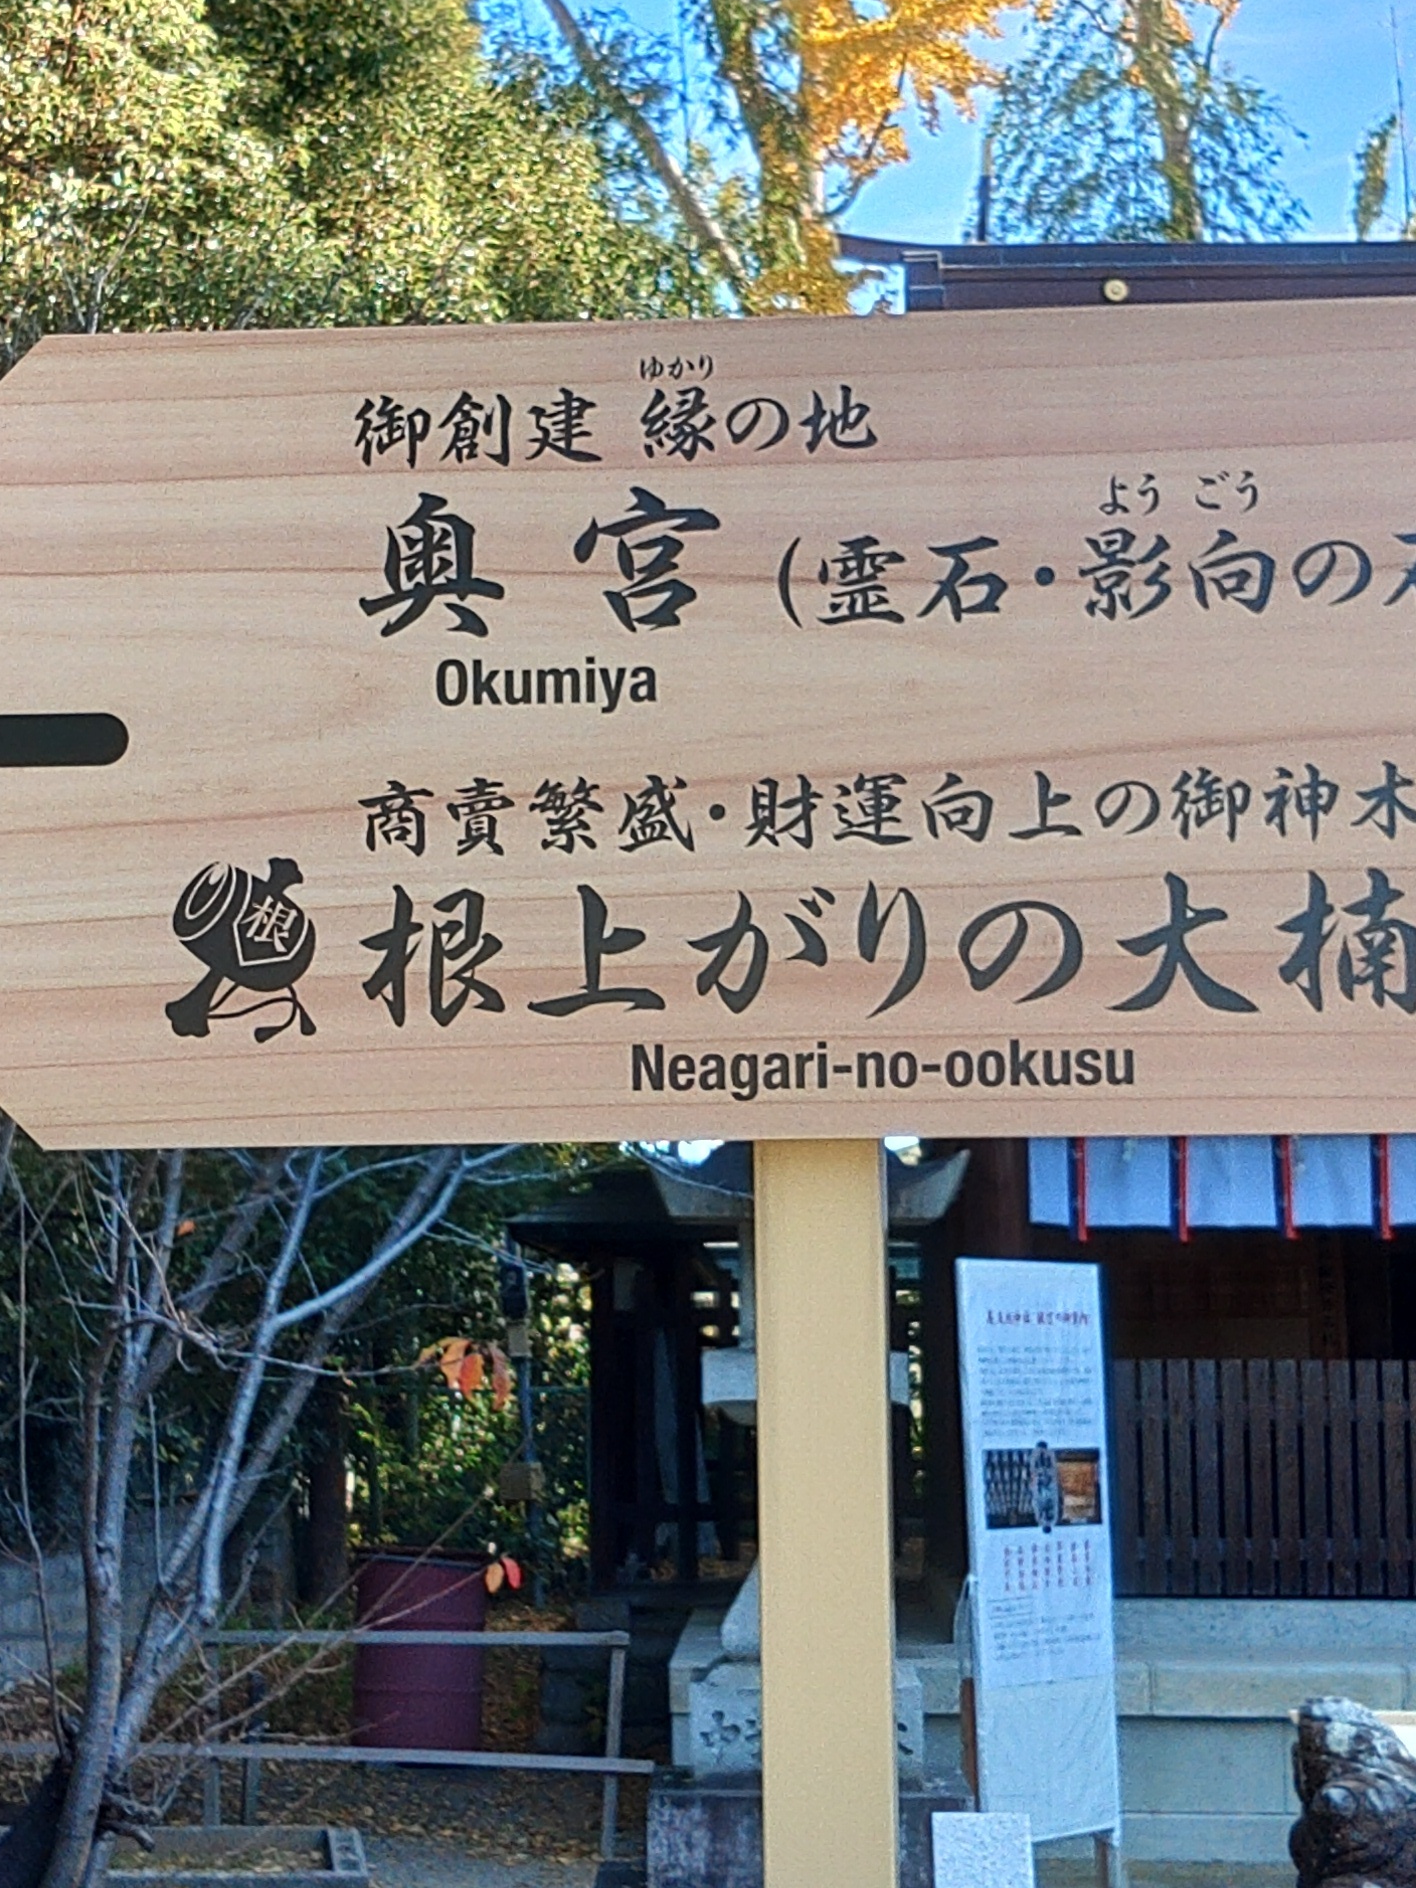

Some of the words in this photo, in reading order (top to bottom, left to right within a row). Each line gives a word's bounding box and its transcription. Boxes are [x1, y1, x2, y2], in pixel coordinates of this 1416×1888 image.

[639, 355, 715, 382] ゆかり
[353, 387, 603, 469] 御創建
[639, 385, 878, 461] 縁の地
[435, 657, 657, 712] Okumiya
[240, 894, 298, 953] 根
[631, 1039, 1135, 1102] Neagari-no-ookusu
